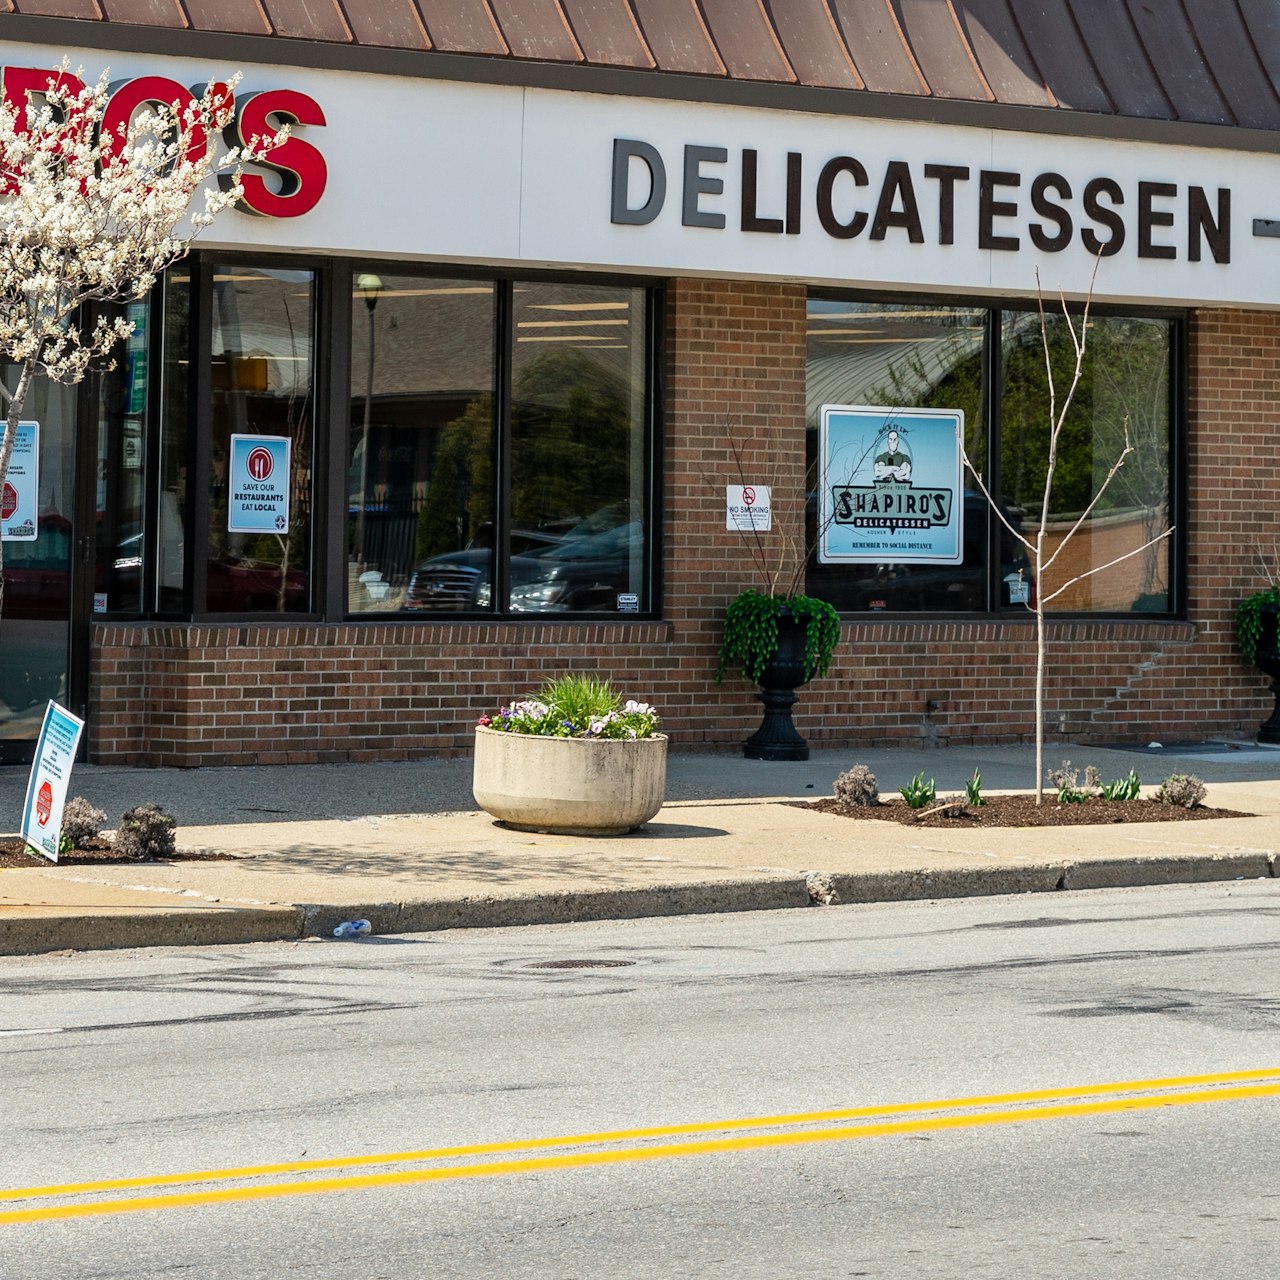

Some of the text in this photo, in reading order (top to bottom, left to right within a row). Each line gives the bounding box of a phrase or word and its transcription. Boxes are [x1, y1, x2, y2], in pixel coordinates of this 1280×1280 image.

[610, 138, 1231, 264] DELICATESSEN
[242, 483, 275, 492] SAVE OUR
[234, 493, 284, 502] RESTAURANTS
[241, 503, 254, 511] EAT
[740, 506, 769, 514] SMOKING
[838, 491, 946, 521] SHAPIRO'S
[856, 518, 928, 527] DELICATESSEN
